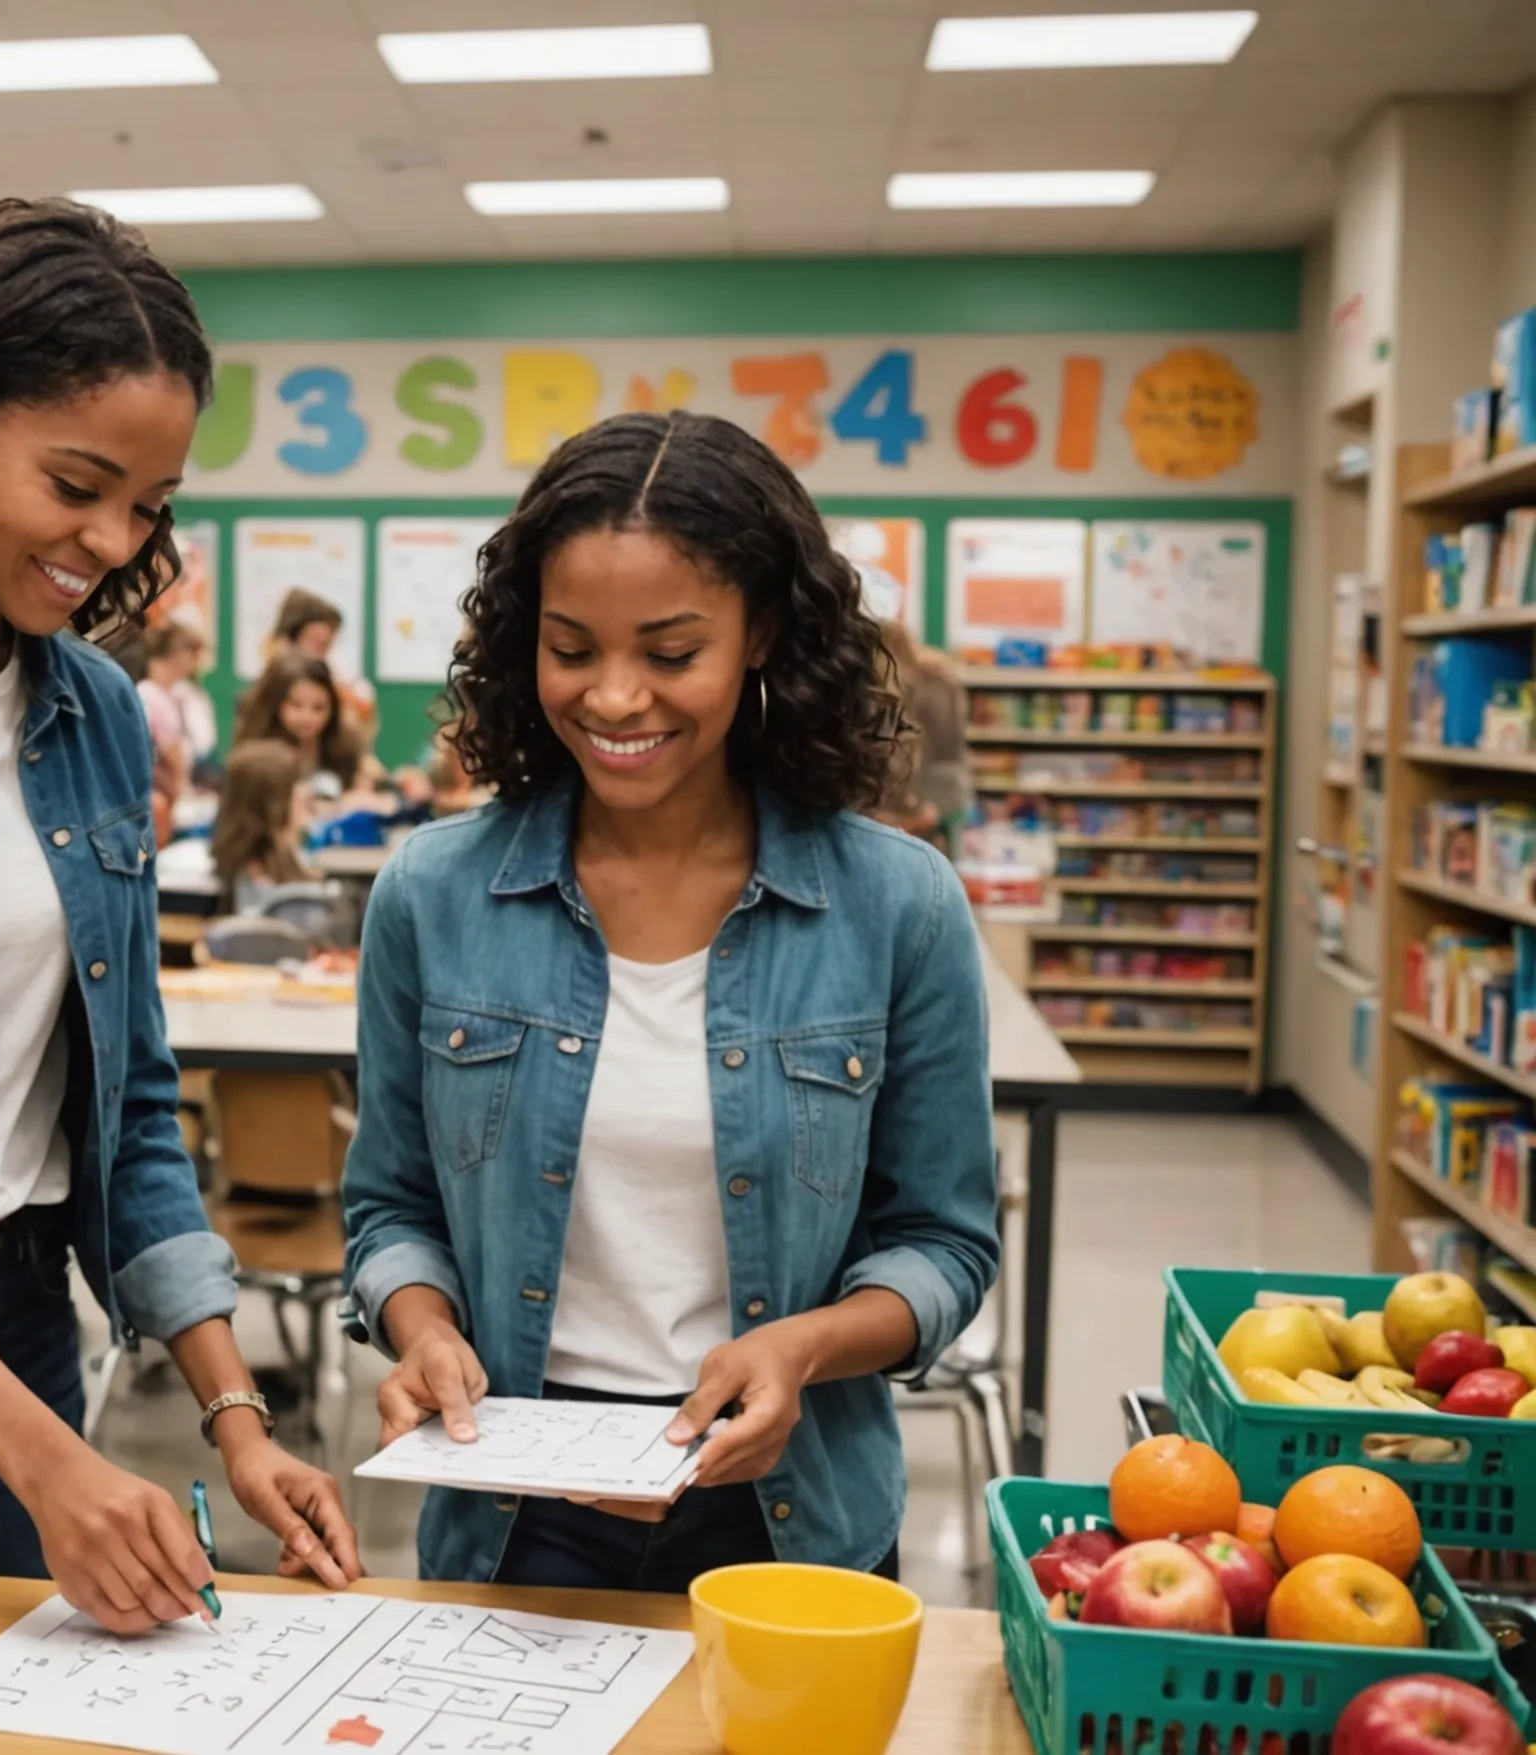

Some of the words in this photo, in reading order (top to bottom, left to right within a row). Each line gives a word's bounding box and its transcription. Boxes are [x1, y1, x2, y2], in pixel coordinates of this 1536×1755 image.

[276, 365, 368, 476] 3
[395, 356, 482, 471] S
[829, 349, 928, 468] 4
[955, 366, 1039, 470] 6
